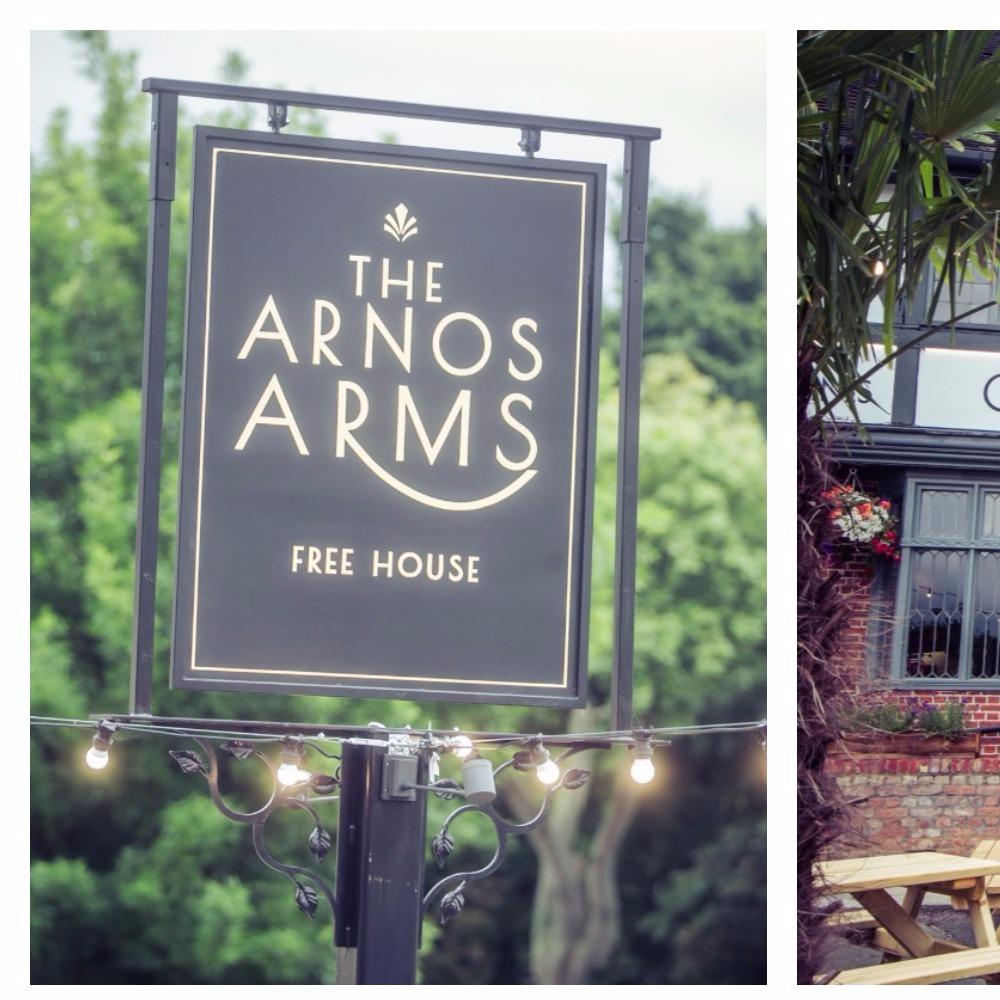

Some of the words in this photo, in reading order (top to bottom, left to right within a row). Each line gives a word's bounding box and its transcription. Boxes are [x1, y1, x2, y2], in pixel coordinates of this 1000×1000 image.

[348, 254, 444, 304] THE
[236, 294, 544, 382] ARNOS
[234, 373, 539, 512] ARMS
[291, 545, 354, 576] FREE
[372, 550, 481, 583] HOUSE
